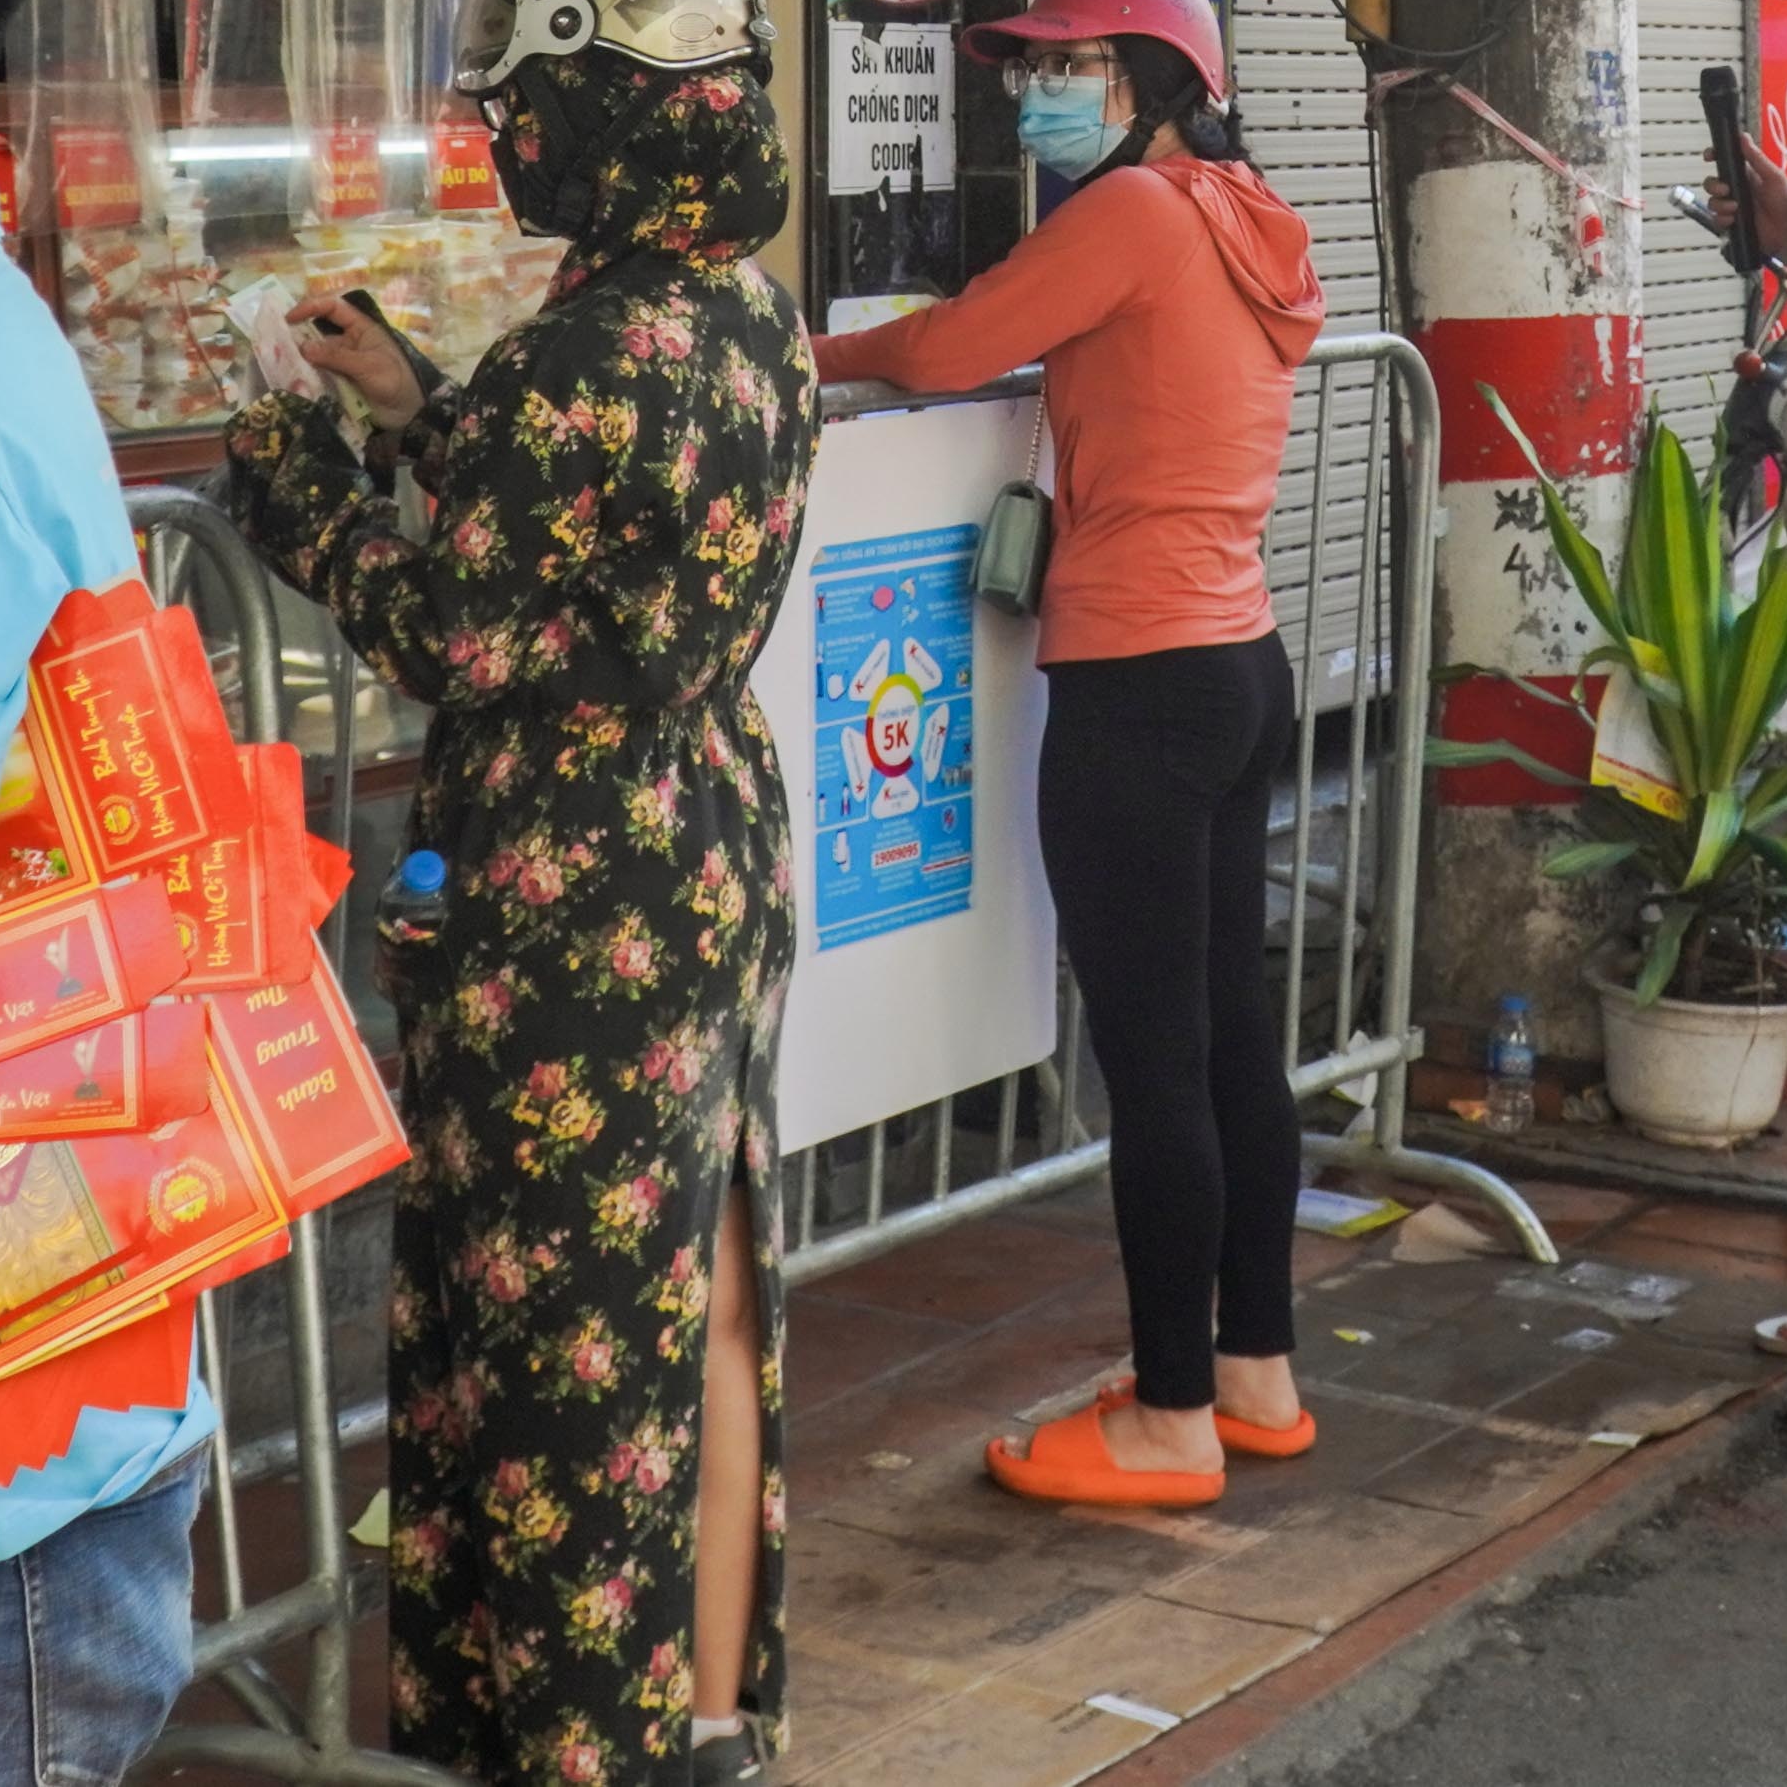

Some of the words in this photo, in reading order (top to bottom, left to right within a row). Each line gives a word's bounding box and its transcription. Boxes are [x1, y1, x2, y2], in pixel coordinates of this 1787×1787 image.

[885, 34, 935, 74] KHUẨN
[848, 84, 899, 123] CHỐNG
[904, 94, 939, 129] DỊCH
[884, 719, 910, 751] 5K
[245, 984, 289, 1014] Thu
[255, 1020, 320, 1066] Trung
[276, 1068, 338, 1112] Bánh
